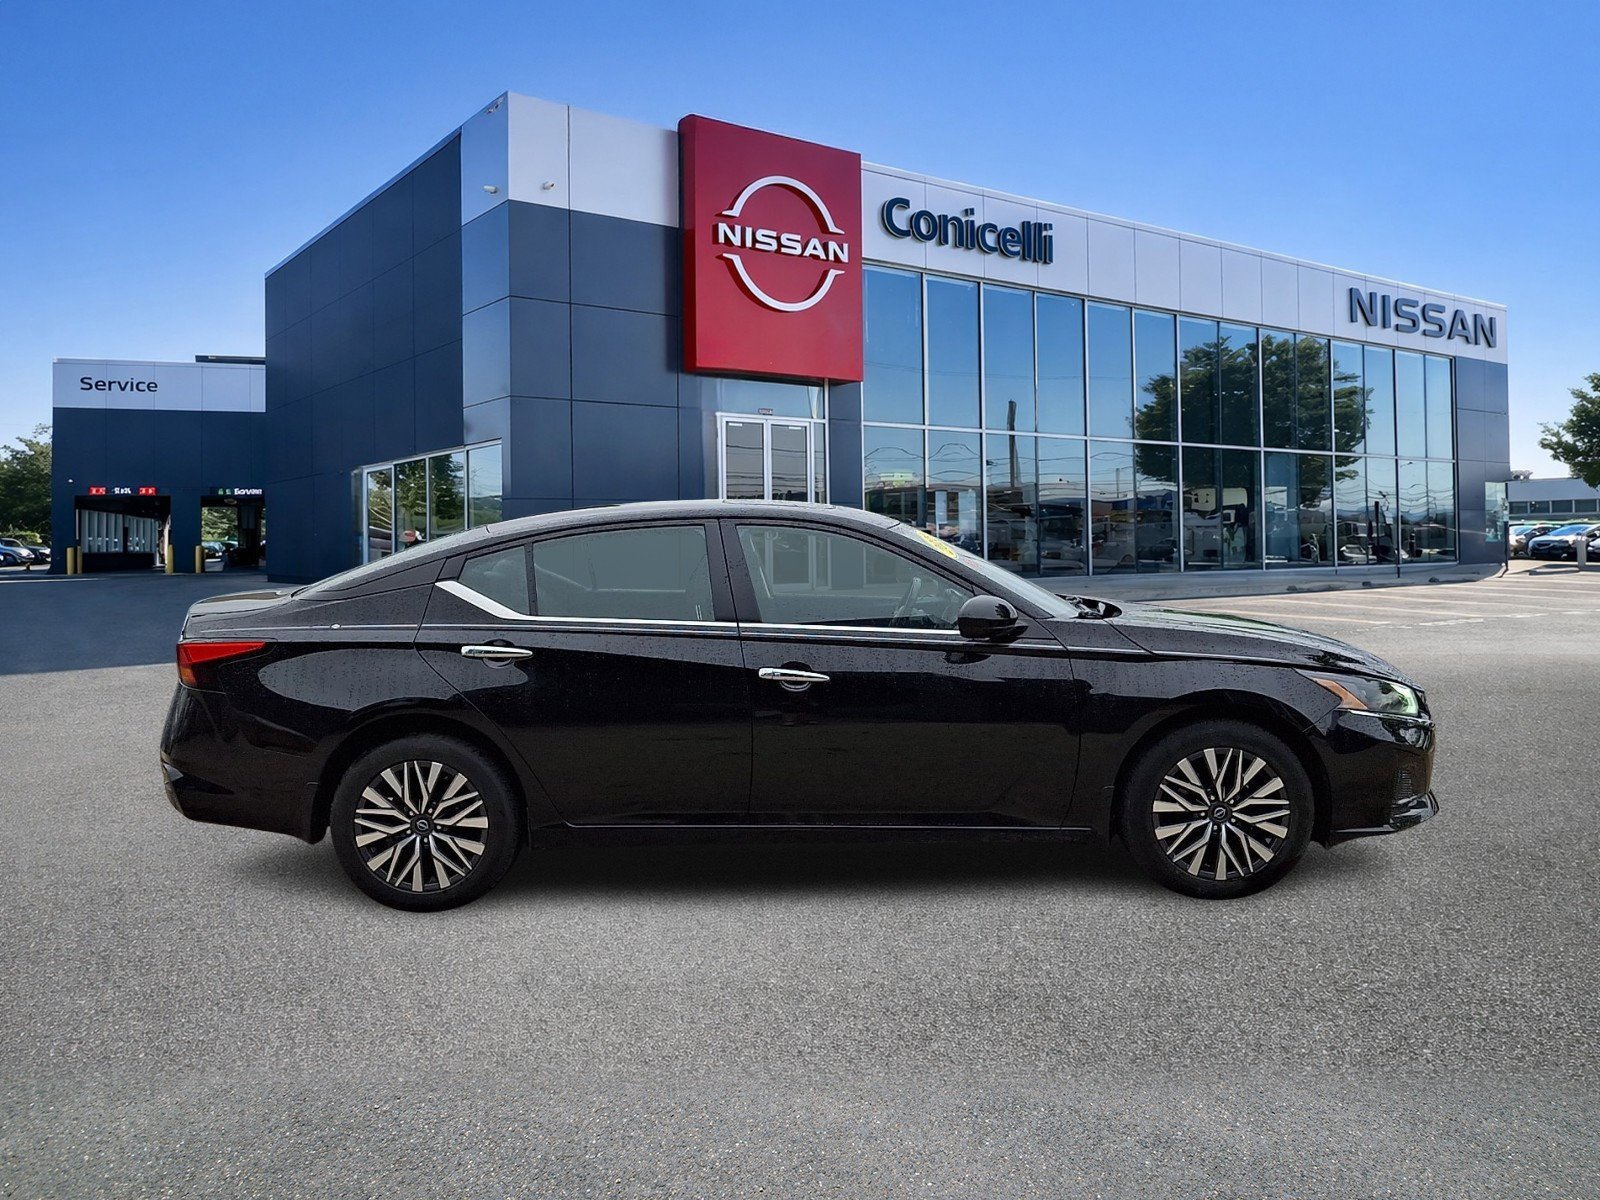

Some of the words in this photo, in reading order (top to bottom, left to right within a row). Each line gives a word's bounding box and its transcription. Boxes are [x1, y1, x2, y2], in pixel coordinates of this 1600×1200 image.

[717, 222, 849, 263] NISSAN
[881, 197, 1053, 264] Conicelli
[1349, 287, 1497, 348] NISSAN
[80, 376, 158, 392] Service
